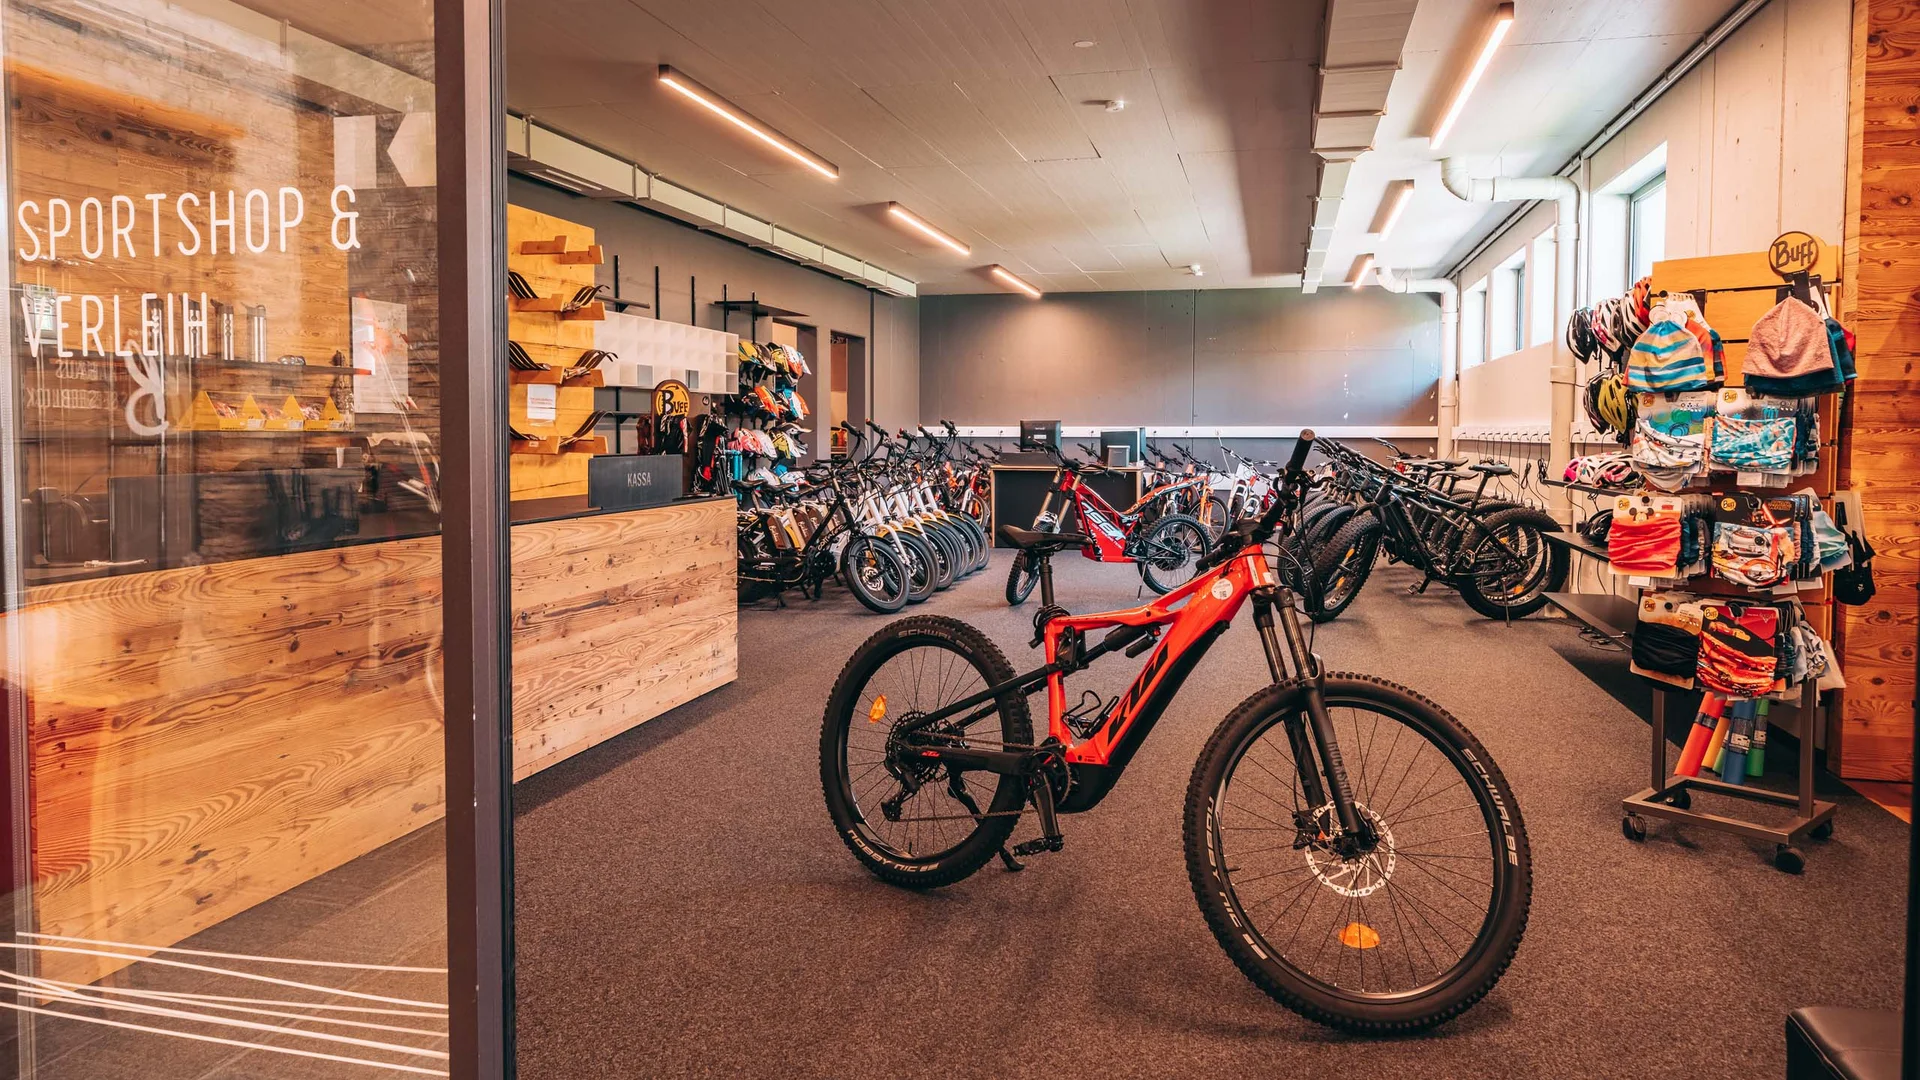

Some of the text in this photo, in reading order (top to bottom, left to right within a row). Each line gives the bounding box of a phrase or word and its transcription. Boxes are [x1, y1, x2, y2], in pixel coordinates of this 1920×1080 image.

[17, 184, 361, 262] SPORTSHOP &
[20, 291, 209, 358] VERLEIH
[627, 472, 652, 488] KASSA
[1461, 748, 1518, 866] SCHWALBE
[847, 829, 918, 873] NOBBY NIC
